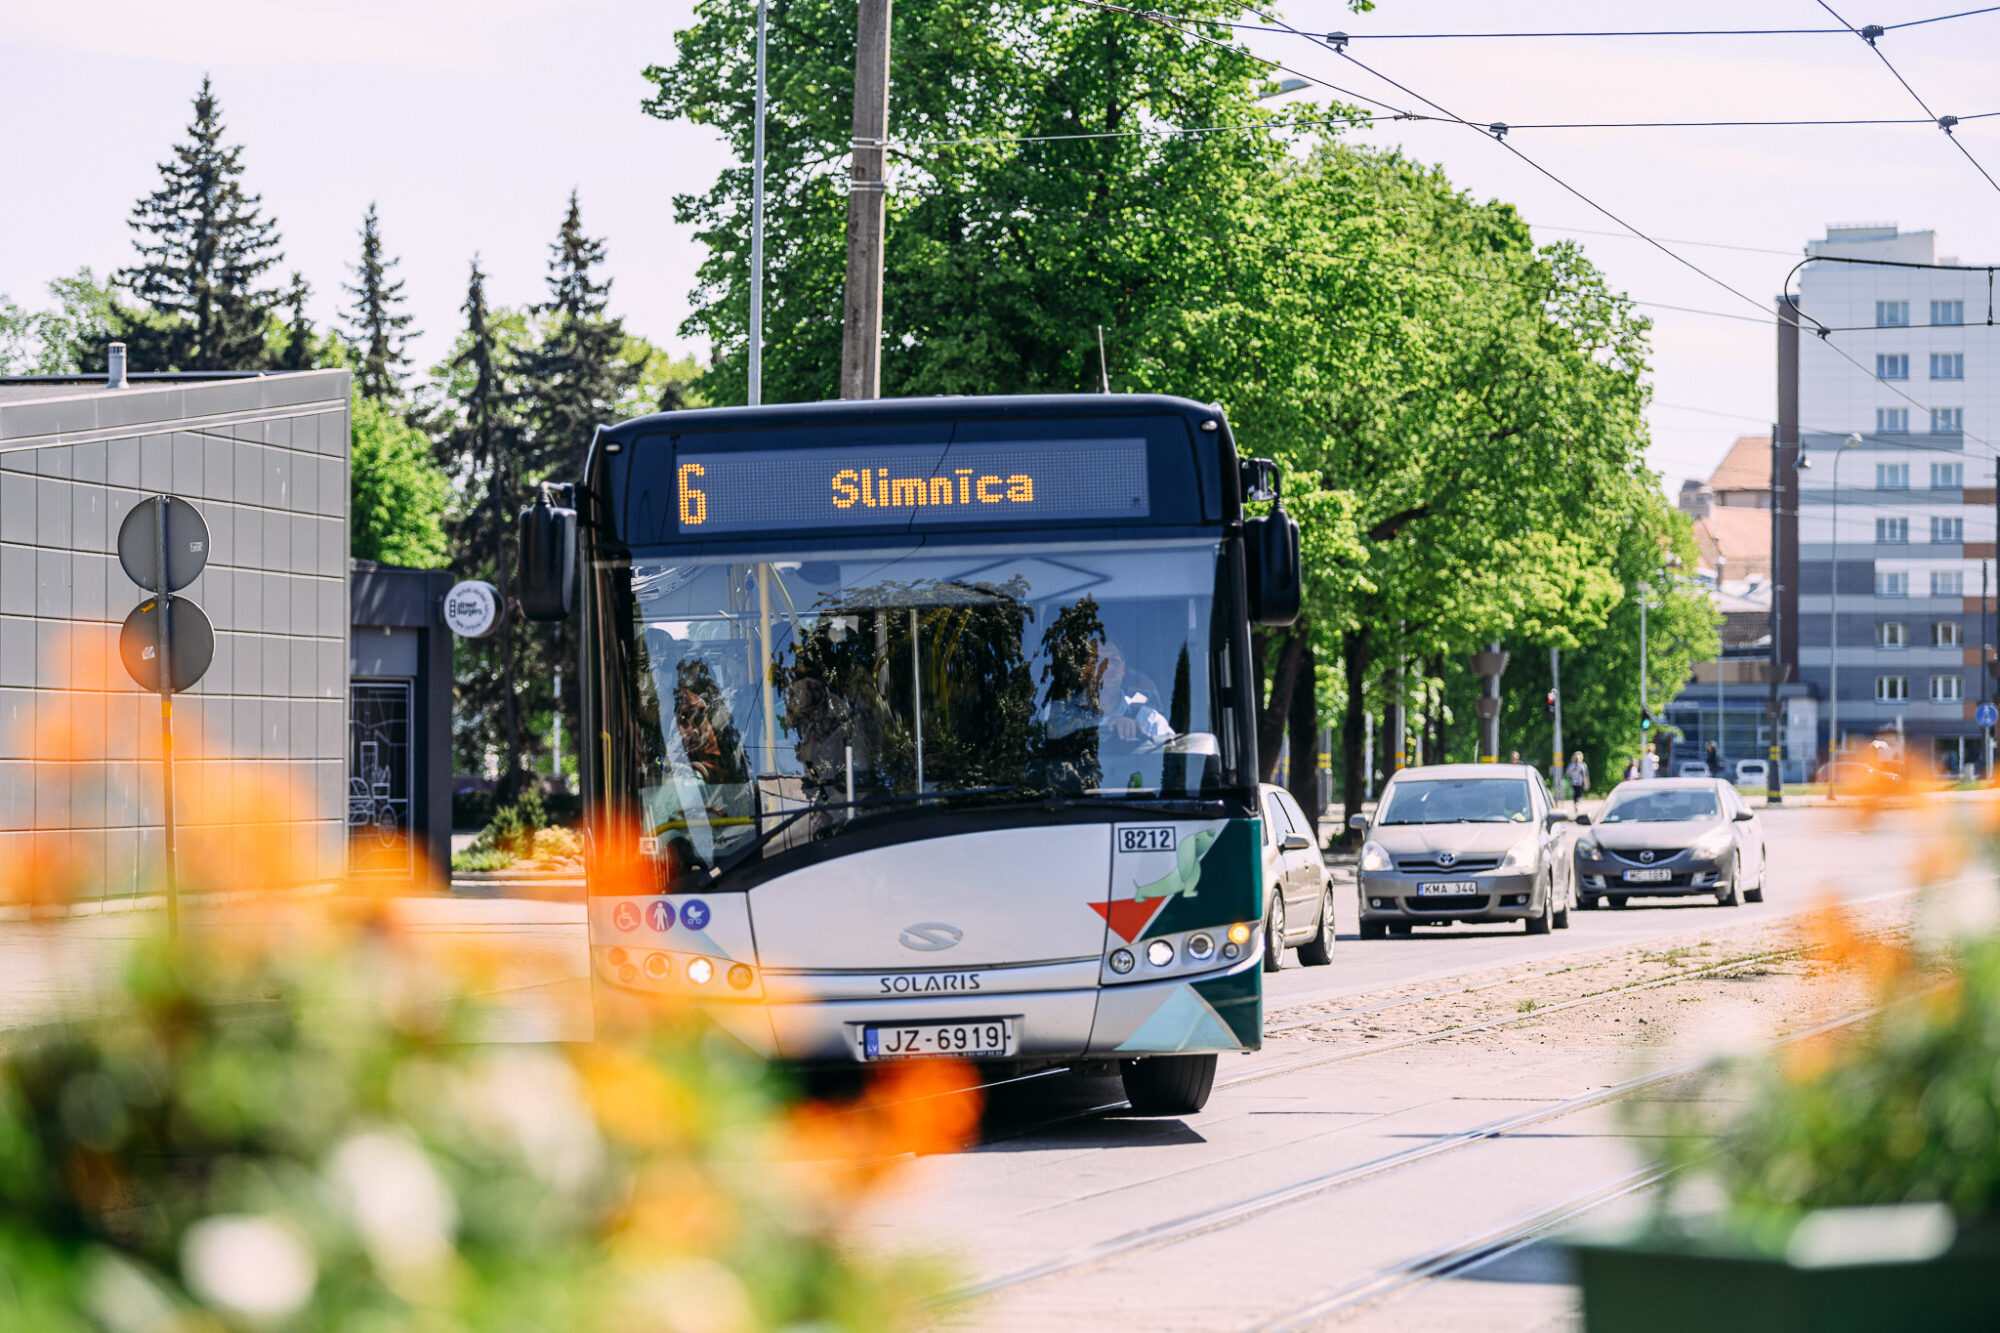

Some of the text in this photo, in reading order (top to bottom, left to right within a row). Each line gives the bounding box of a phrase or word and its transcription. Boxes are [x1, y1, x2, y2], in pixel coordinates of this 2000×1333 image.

[678, 463, 1034, 525] 6 Slimnīca
[1124, 829, 1171, 849] 8212
[1455, 882, 1475, 894] 344
[880, 973, 980, 994] SOLARIS
[867, 1044, 878, 1053] LV
[886, 1026, 999, 1052] JZ-6919
